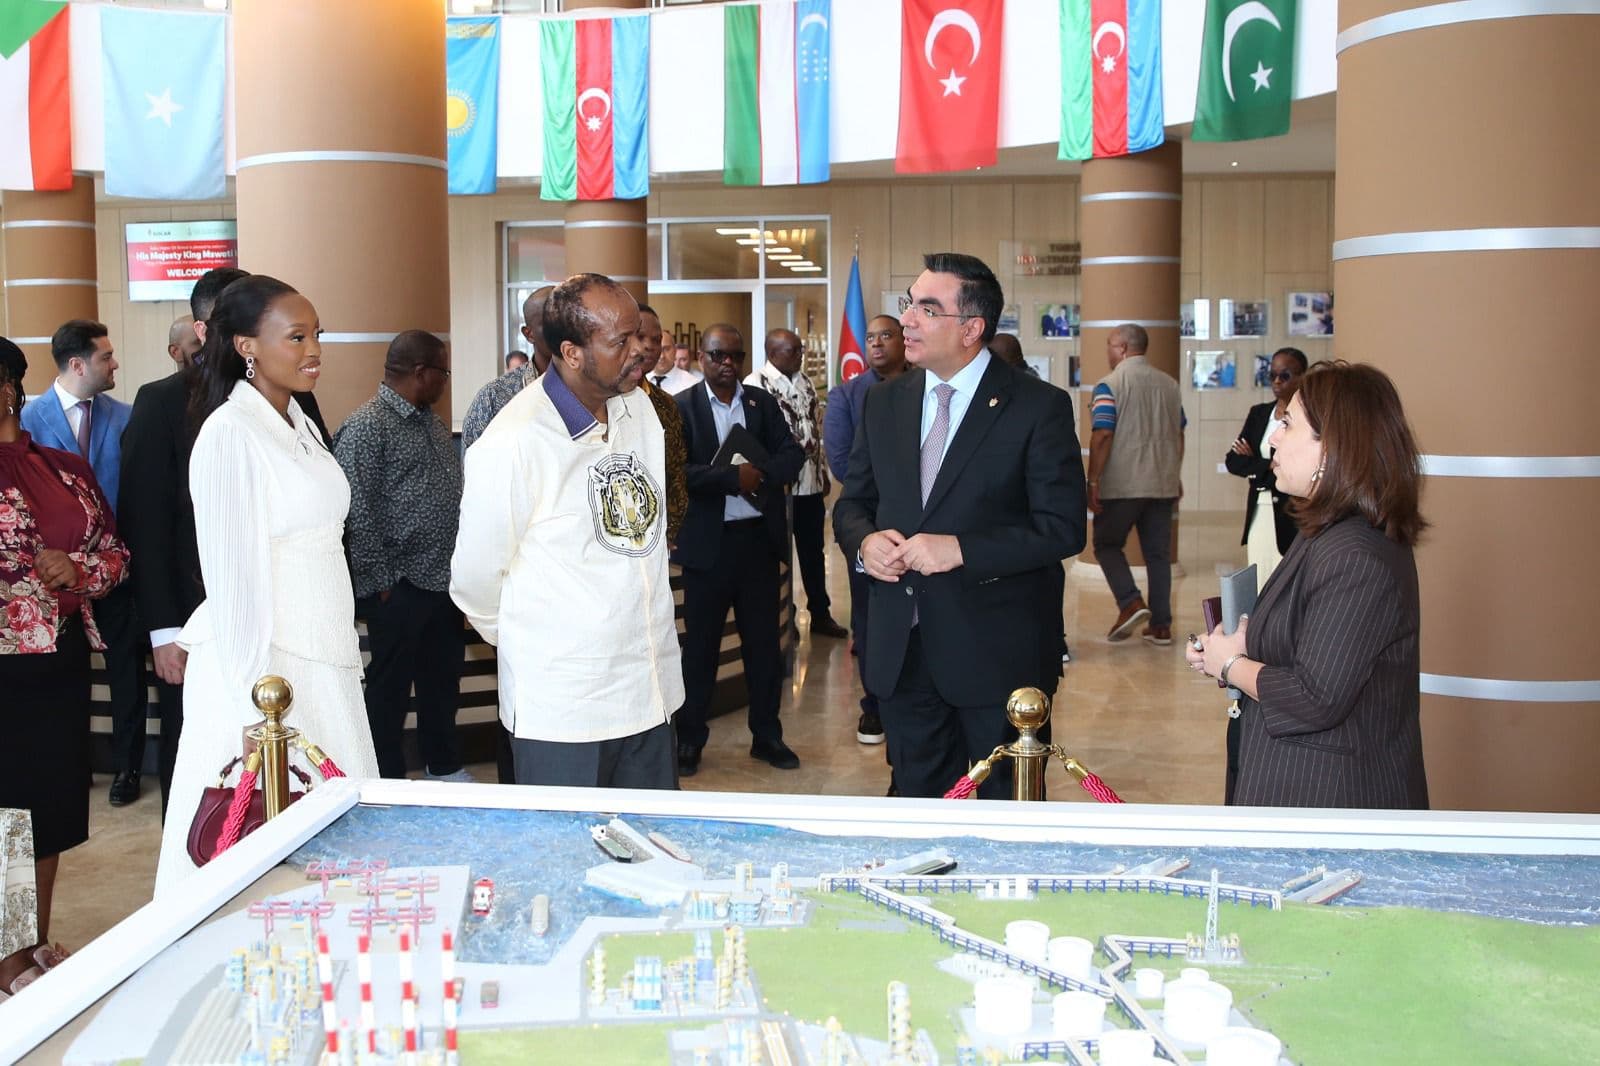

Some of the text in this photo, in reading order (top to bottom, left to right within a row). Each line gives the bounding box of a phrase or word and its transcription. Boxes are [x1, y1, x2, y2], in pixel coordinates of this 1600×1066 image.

[135, 251, 149, 261] His
[150, 251, 182, 261] Majesty
[183, 250, 202, 260] King
[166, 268, 213, 278] WELCOM
